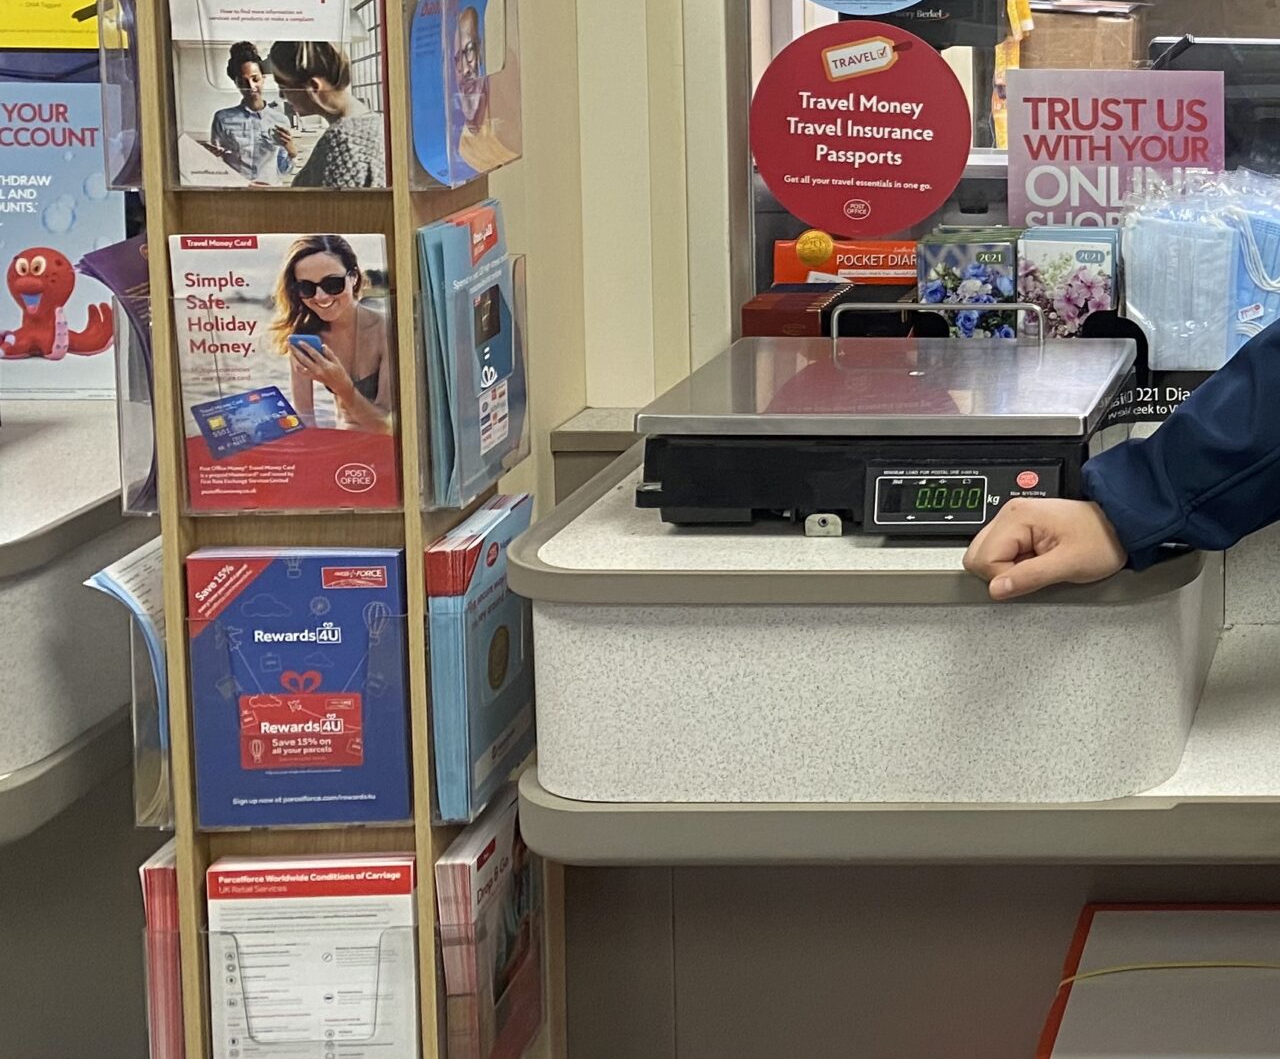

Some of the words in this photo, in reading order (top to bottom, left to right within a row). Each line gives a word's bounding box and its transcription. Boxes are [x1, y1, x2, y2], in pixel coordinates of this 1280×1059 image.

[915, 9, 943, 19] Berkel
[831, 50, 878, 70] TRAVEL
[2, 103, 70, 123] YOUR
[799, 92, 855, 111] Travel
[859, 95, 924, 119] Money
[1022, 97, 1147, 132] TRUST
[1156, 99, 1208, 132] US
[786, 116, 842, 138] Travel
[847, 120, 934, 142] Insurance
[815, 145, 903, 168] Passports
[1023, 135, 1112, 162] WITH
[1118, 135, 1210, 163] YOUR
[783, 174, 800, 184] Get
[800, 175, 811, 184] all
[811, 175, 831, 187] your
[831, 176, 855, 185] travel
[855, 178, 893, 189] essentials
[903, 182, 919, 190] one
[8, 188, 37, 200] AND
[186, 239, 208, 248] Travel
[209, 239, 233, 249] Money
[234, 239, 252, 248] Card
[836, 254, 886, 267] POCKET
[888, 254, 917, 266] DIAR
[979, 252, 1003, 264] 2021
[1078, 251, 1102, 263] 2021
[184, 272, 250, 289] Simple.
[186, 294, 230, 311] Safe.
[187, 316, 257, 333] Holiday
[190, 339, 256, 357] Money.
[1156, 405, 1168, 415] to
[340, 477, 371, 485] OFFICE
[344, 469, 367, 477] POST
[915, 487, 982, 509] 0.000
[986, 494, 1001, 506] kg
[195, 580, 217, 602] Save
[213, 563, 235, 583] 15%
[272, 738, 296, 747] Save
[297, 737, 318, 746] 15%
[218, 875, 264, 885] Parcelforce
[265, 873, 309, 883] Worldwide
[310, 872, 354, 882] Conditions
[355, 871, 365, 880] of
[365, 871, 402, 881] Carriage
